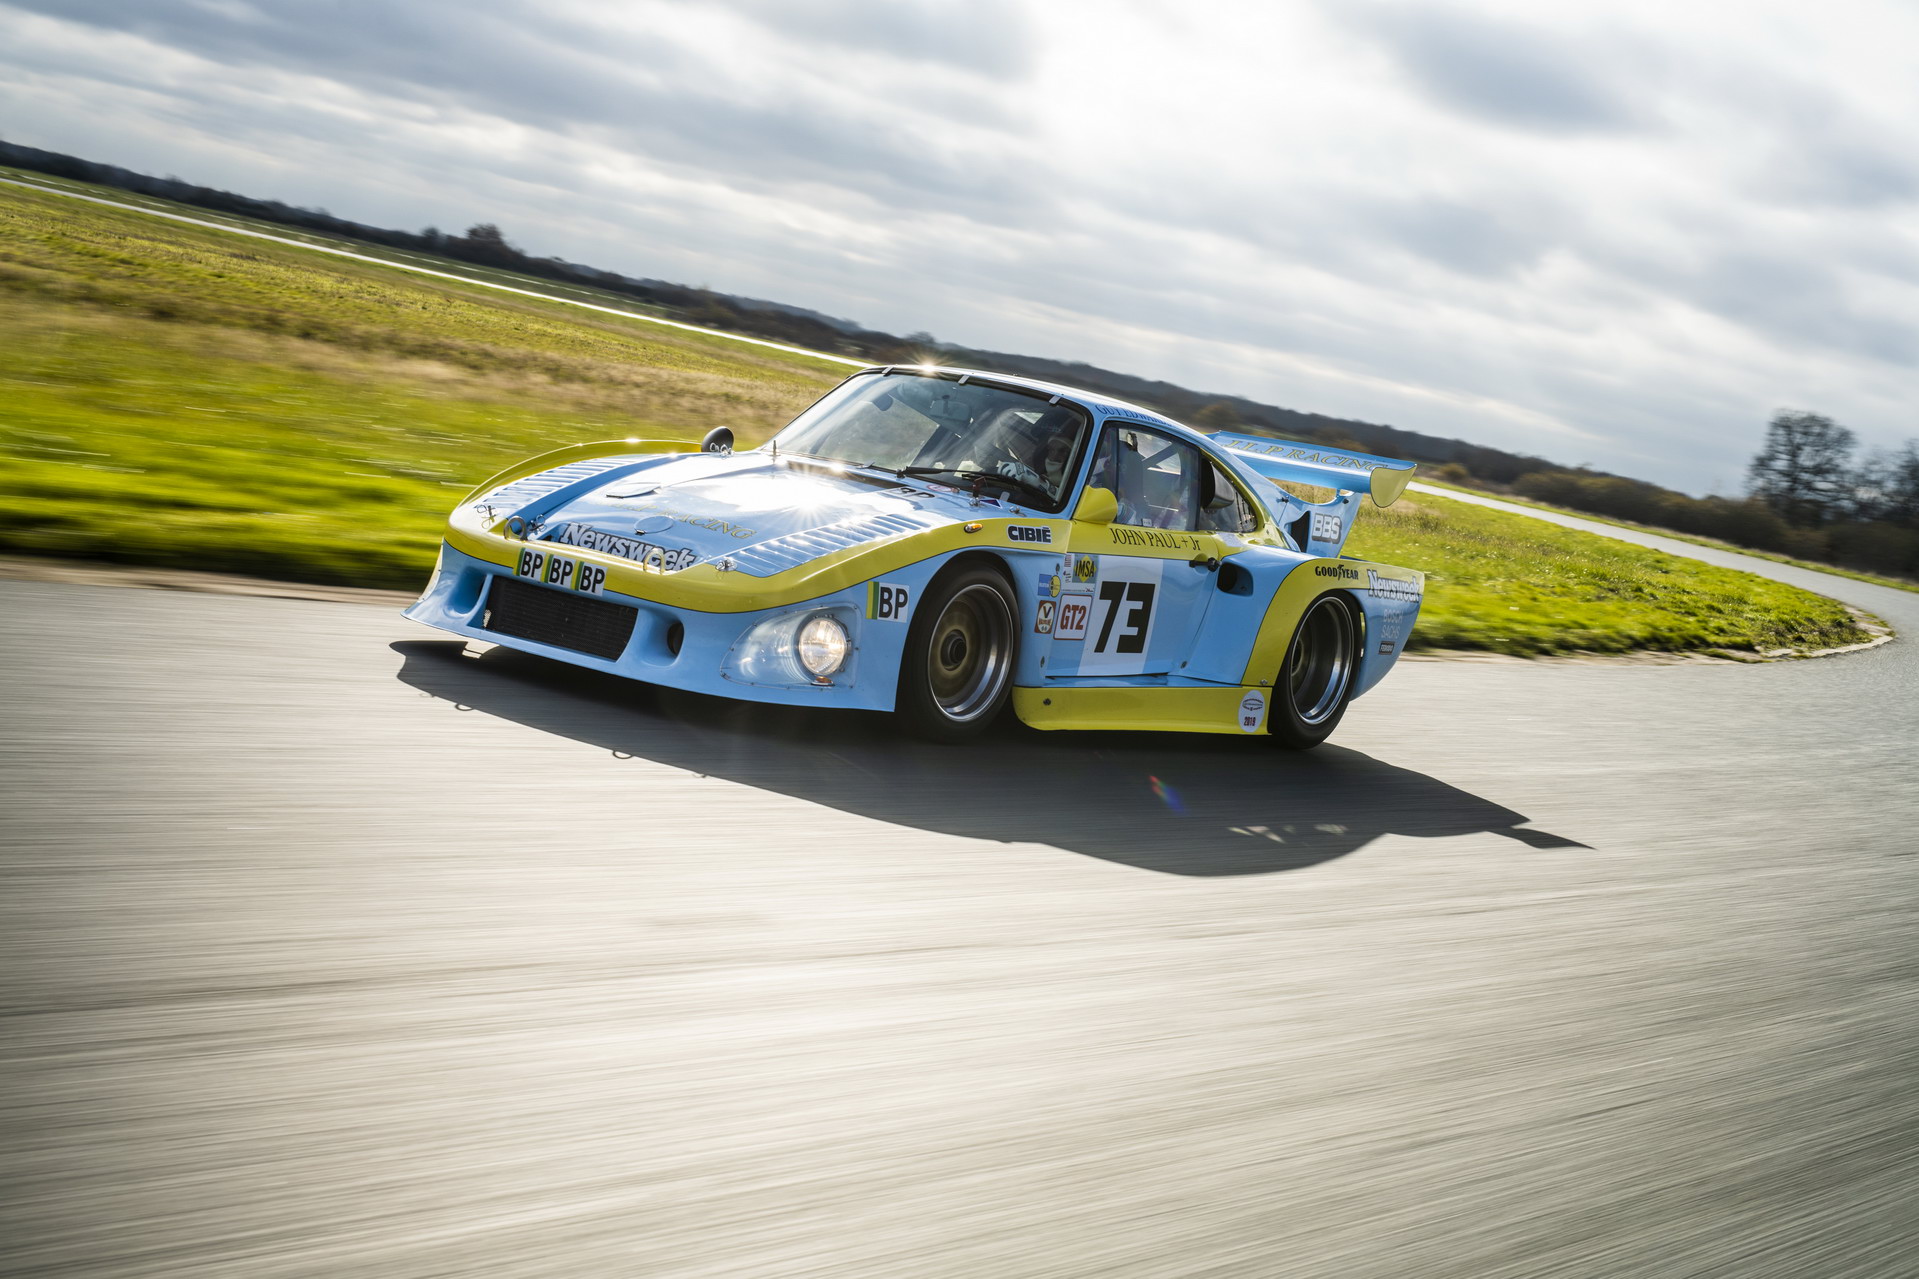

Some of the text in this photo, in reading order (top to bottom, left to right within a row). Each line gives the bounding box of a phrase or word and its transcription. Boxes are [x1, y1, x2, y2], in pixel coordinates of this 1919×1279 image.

[1109, 527, 1147, 546] JOHN
[1145, 531, 1181, 549] PAUL
[1311, 513, 1342, 544] BBS
[560, 522, 698, 572] Newsweek
[520, 551, 605, 593] BP BP BP
[1075, 560, 1095, 578] IMSA
[1367, 569, 1420, 603] Newsweek
[878, 586, 909, 620] BP
[1060, 604, 1087, 631] GT2
[1094, 581, 1156, 654] 73
